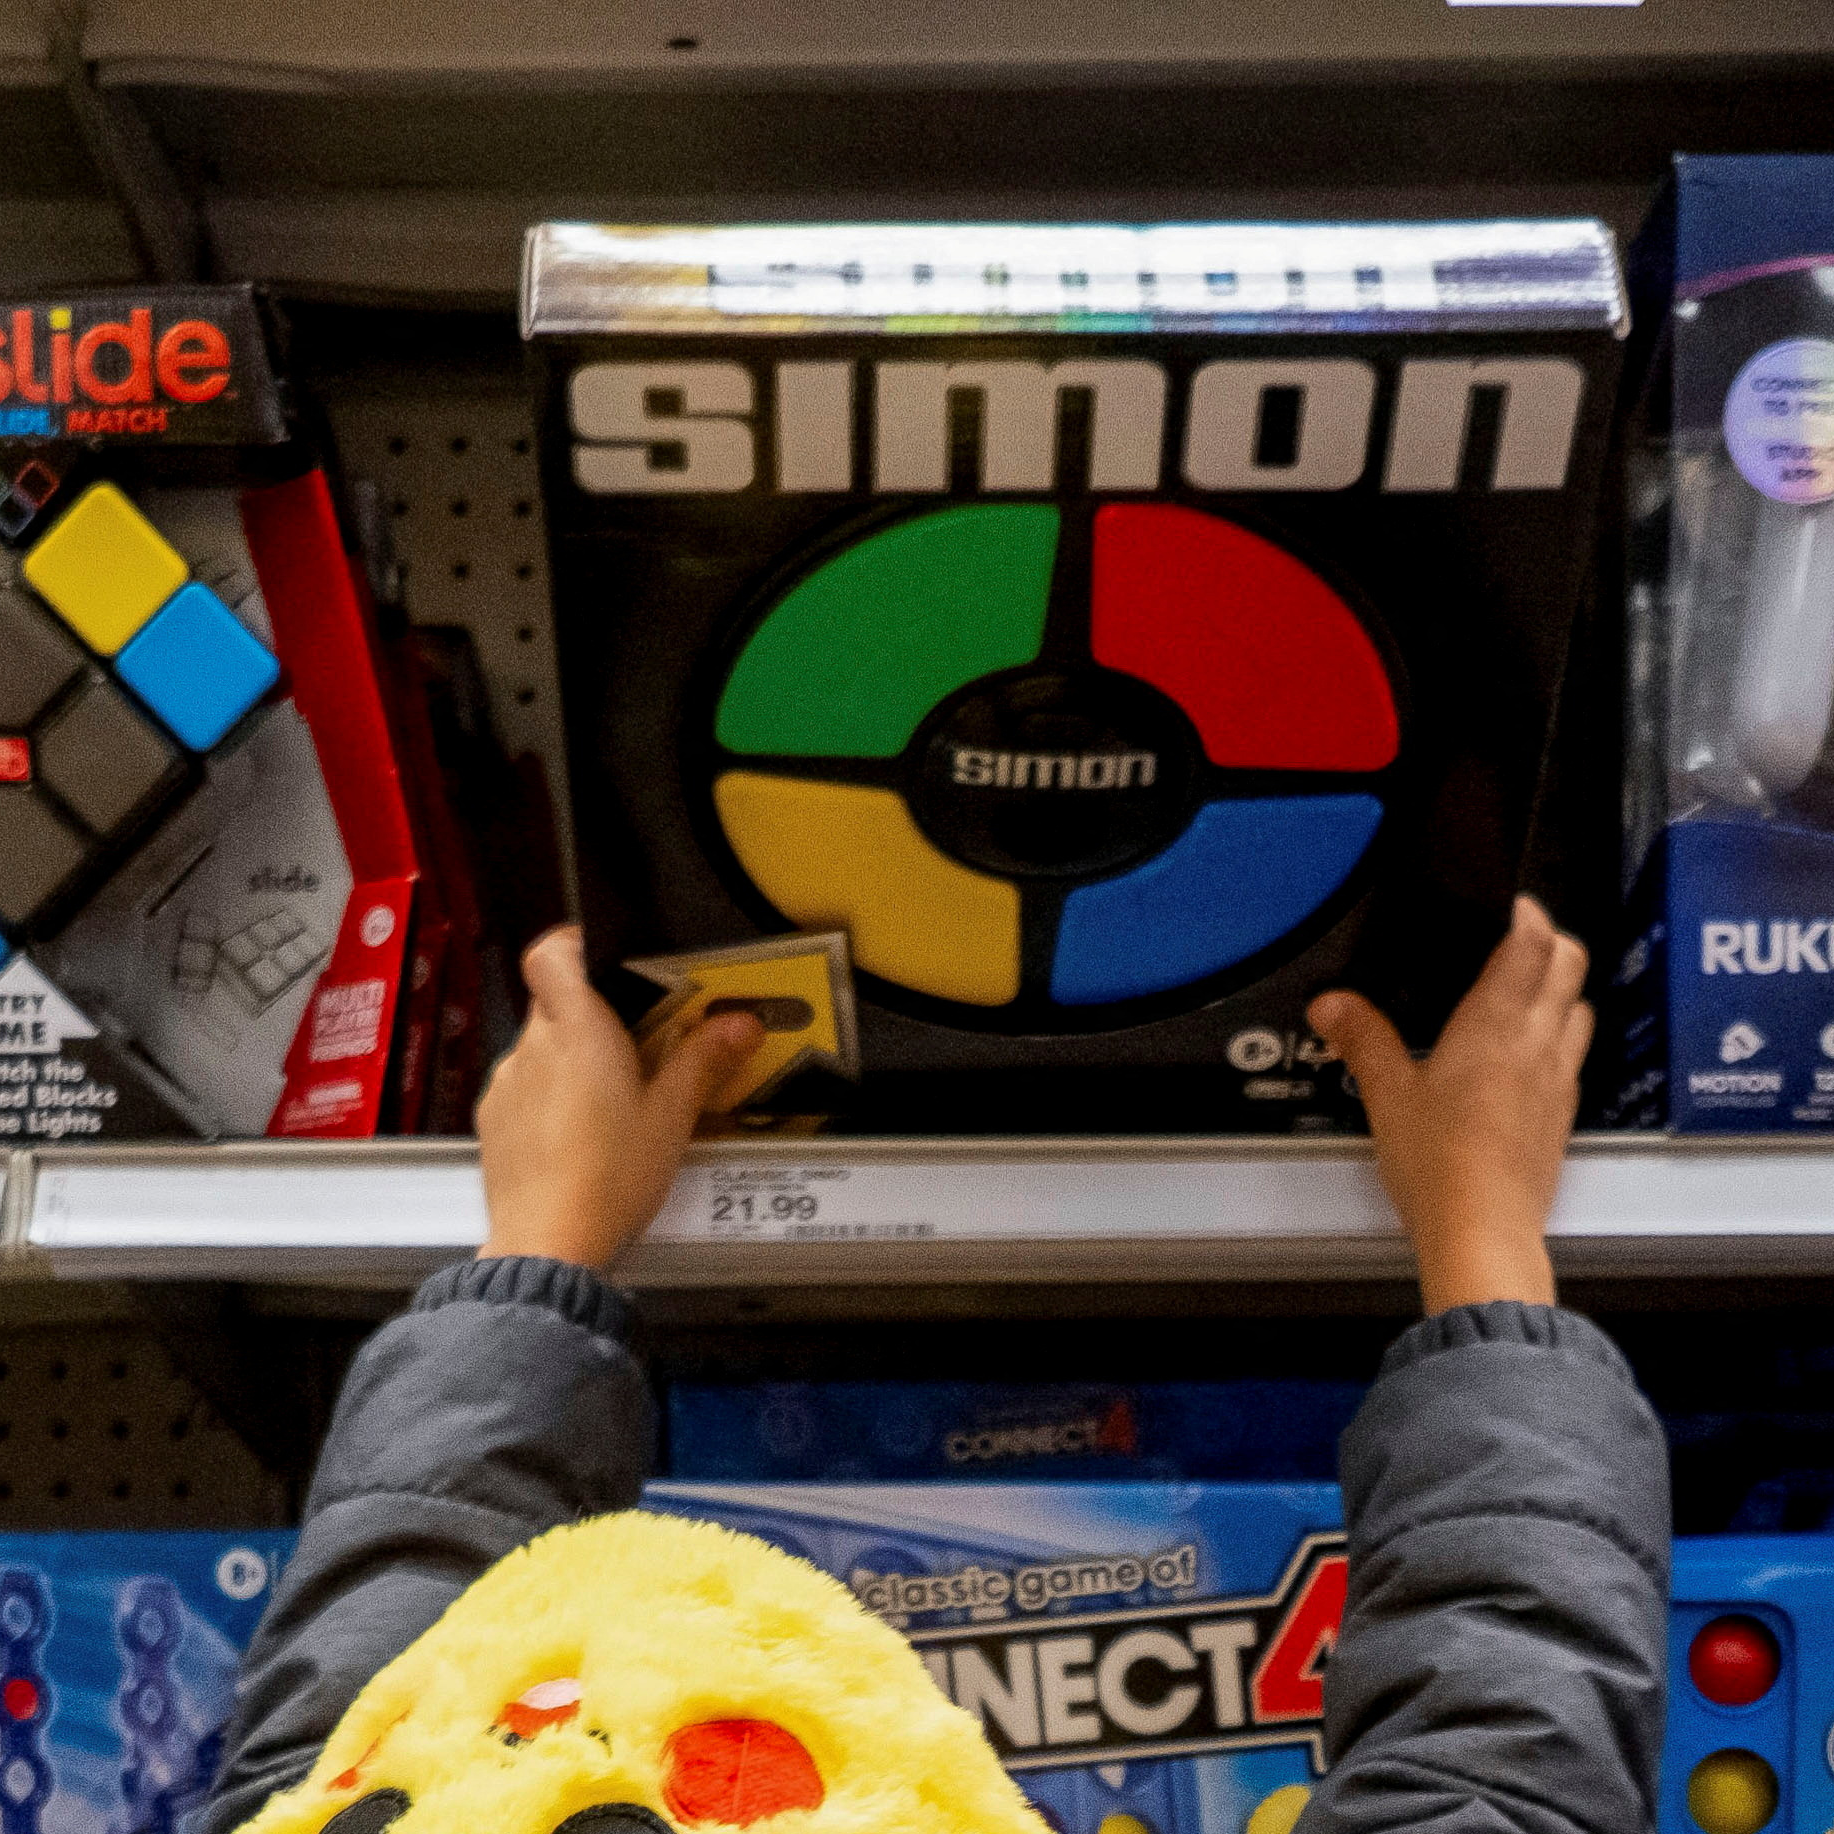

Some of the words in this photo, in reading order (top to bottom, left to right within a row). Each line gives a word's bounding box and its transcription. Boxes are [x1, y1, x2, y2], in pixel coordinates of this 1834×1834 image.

[44, 1058, 86, 1084] the
[1688, 1071, 1783, 1094] MOTION
[34, 1083, 118, 1110] Blocks
[29, 1109, 102, 1139] Lights
[712, 1194, 818, 1222] 21.99
[865, 1569, 1013, 1614] classic
[1018, 1560, 1145, 1611] game
[1152, 1549, 1197, 1587] of
